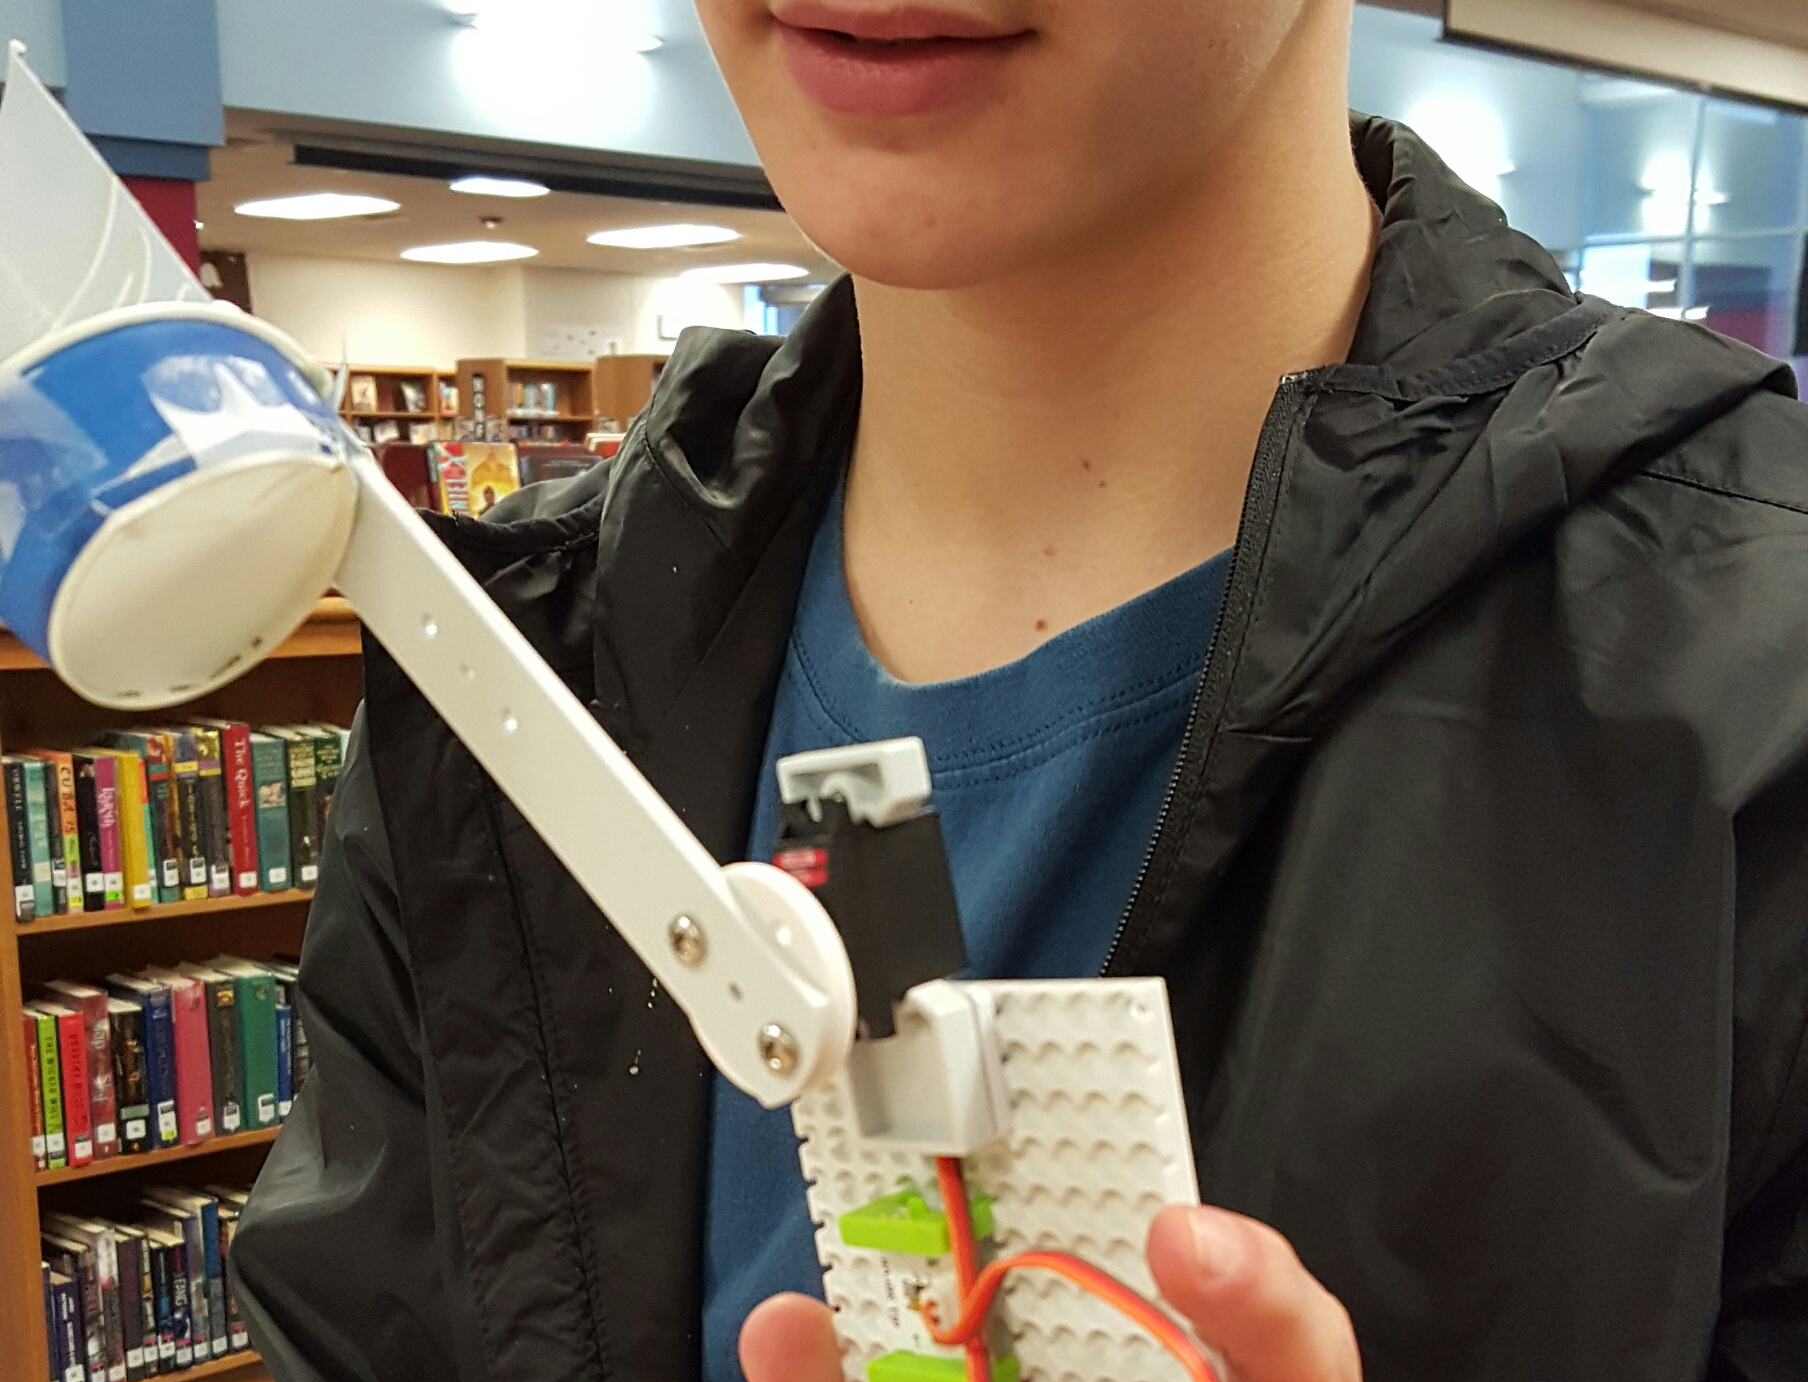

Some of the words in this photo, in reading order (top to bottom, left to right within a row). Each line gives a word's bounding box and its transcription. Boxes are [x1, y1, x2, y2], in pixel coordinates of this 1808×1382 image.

[234, 739, 246, 765] The
[60, 766, 73, 813] CUBA
[174, 1278, 187, 1307] FANG
